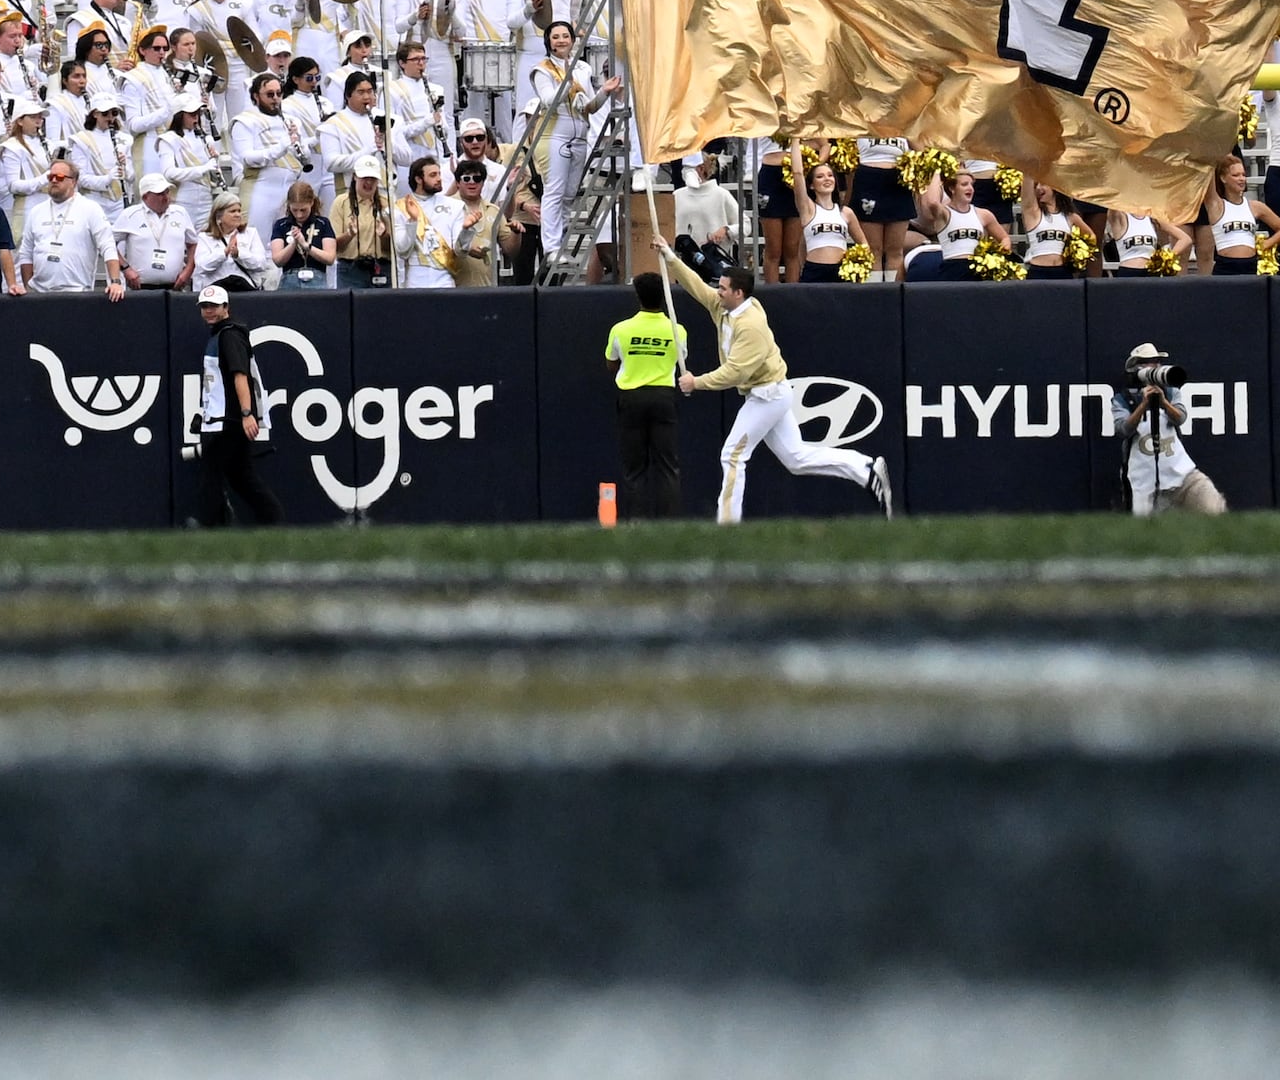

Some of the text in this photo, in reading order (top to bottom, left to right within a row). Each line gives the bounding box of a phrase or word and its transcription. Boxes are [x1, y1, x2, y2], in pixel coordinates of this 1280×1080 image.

[868, 138, 905, 149] TECH
[811, 223, 847, 236] TECH
[1223, 222, 1257, 235] TECH
[1123, 236, 1156, 248] TEC
[629, 337, 672, 348] BEST
[906, 384, 1248, 438] HYUNAI
